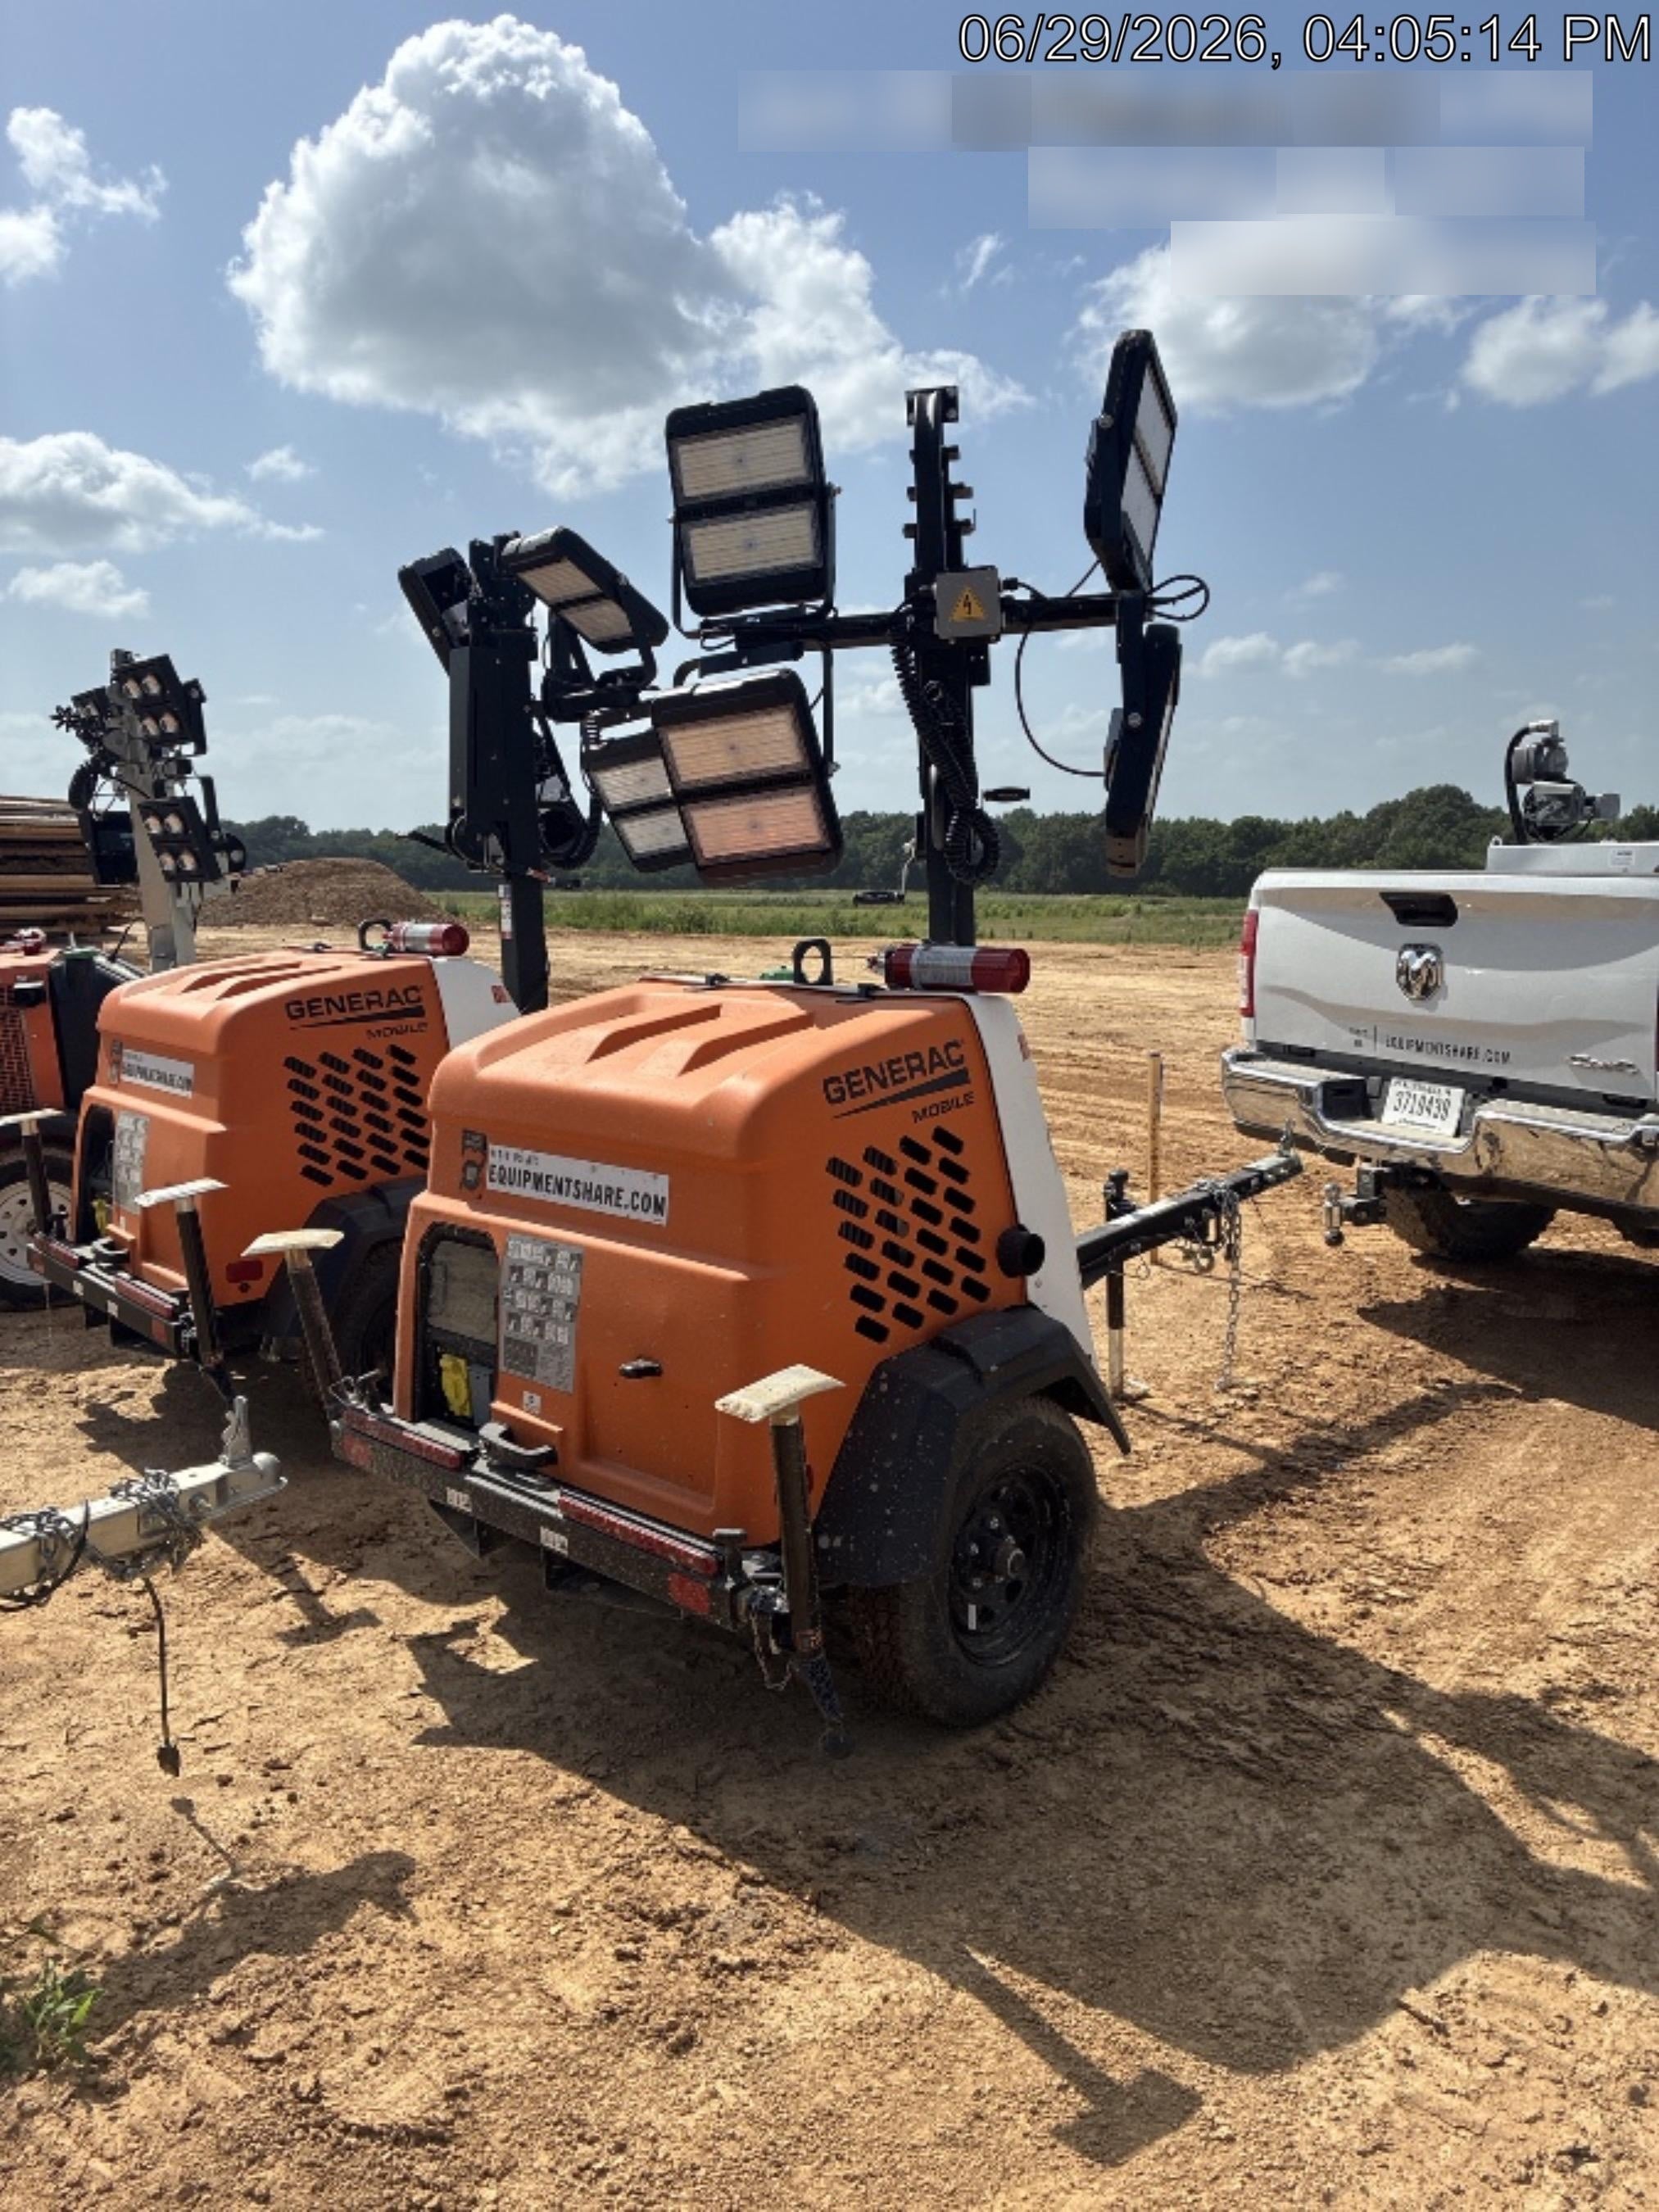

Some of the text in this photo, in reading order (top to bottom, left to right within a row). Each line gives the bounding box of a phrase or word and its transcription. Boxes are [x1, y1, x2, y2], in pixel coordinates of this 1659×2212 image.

[285, 986, 422, 1020] GENERAC
[823, 1040, 964, 1104] GENERAC
[912, 1091, 974, 1123] MOBILE
[489, 1164, 666, 1217] EQUIPMENTSHARE.COM
